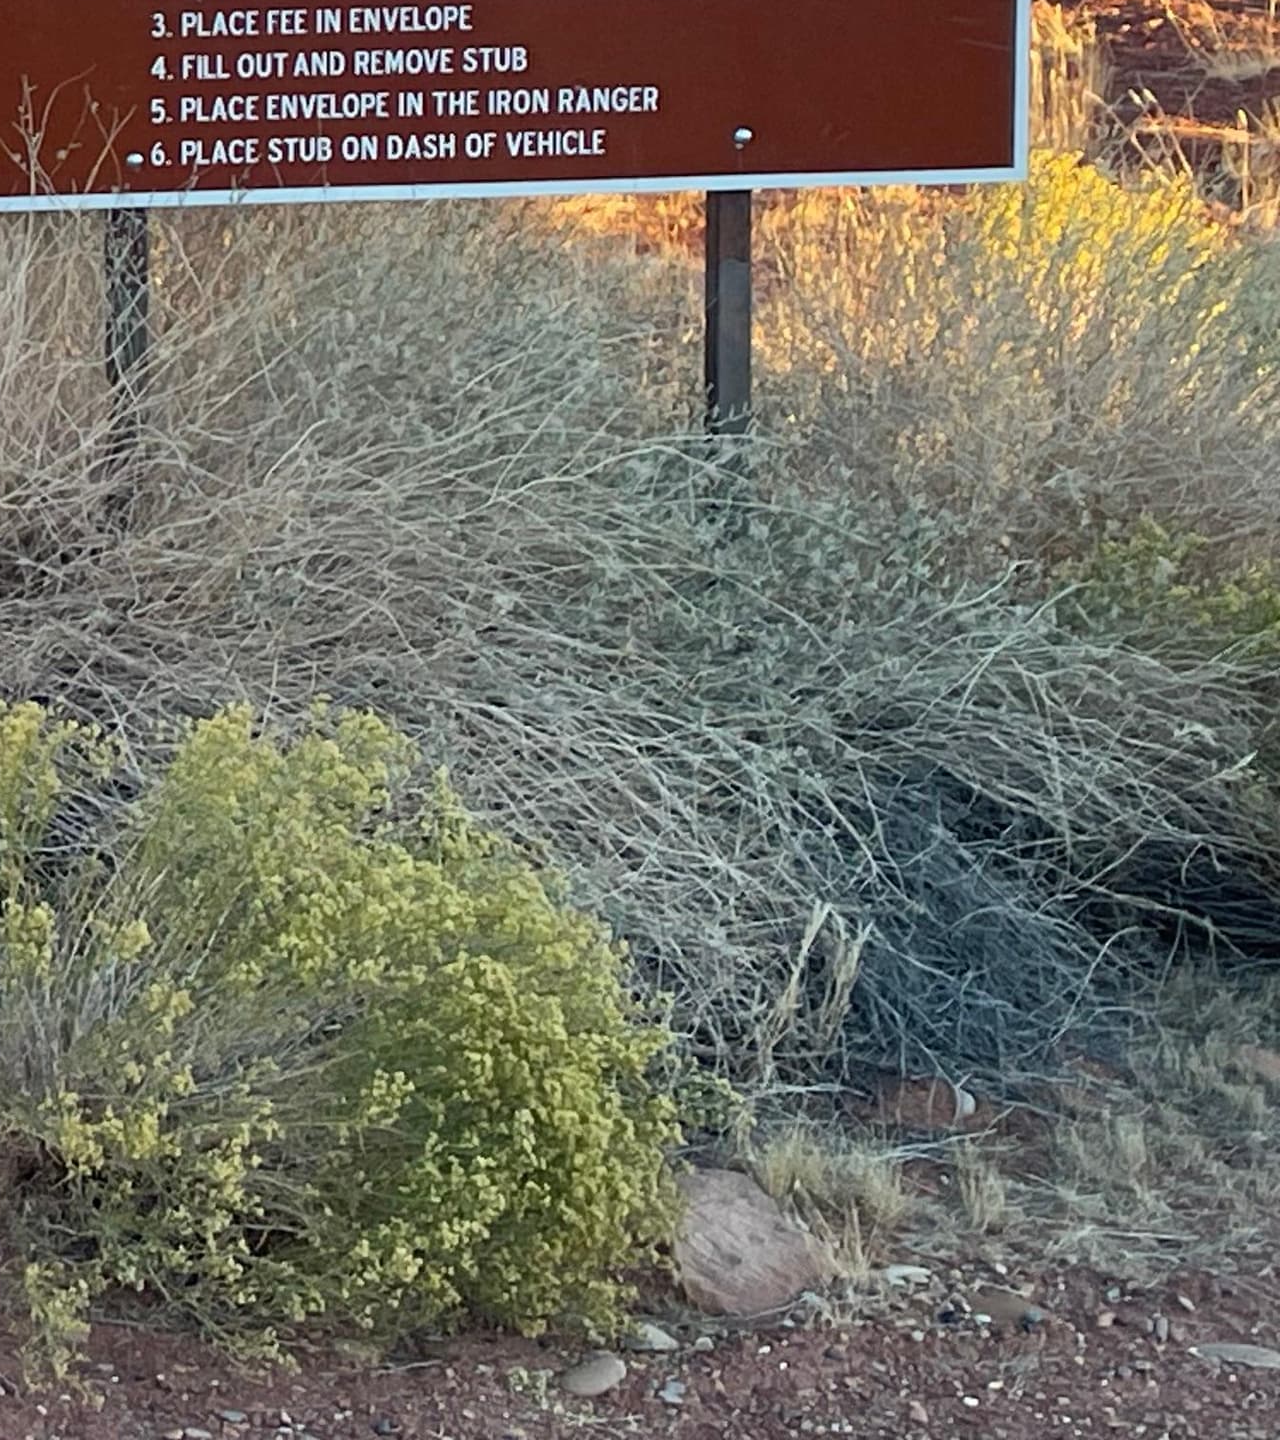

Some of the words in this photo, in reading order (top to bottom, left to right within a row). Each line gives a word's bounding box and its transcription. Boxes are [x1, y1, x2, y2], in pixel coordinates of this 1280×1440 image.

[151, 12, 173, 38] 3.
[181, 10, 260, 38] PLACE
[266, 8, 308, 35] FEE
[316, 8, 341, 34] IN
[349, 4, 473, 33] ENVELOPE
[151, 55, 174, 81] 4.
[182, 54, 231, 80] FILL
[236, 52, 289, 79] OUT
[293, 50, 346, 77] AND
[353, 48, 454, 76] REMOVE
[462, 46, 528, 73] STUB
[150, 98, 173, 124] 5.
[180, 95, 260, 122] PLACE
[266, 91, 390, 121] ENVELOPE
[398, 91, 424, 117] IN
[431, 90, 480, 117] THE
[488, 88, 549, 115] IRON
[557, 86, 659, 114] RANGER
[150, 141, 172, 167] 6.
[181, 138, 261, 165] PLACE
[267, 136, 333, 164] STUB
[341, 135, 378, 161] ON
[386, 133, 456, 160] DASH
[465, 132, 497, 158] OF
[505, 129, 606, 157] VEHICLE
